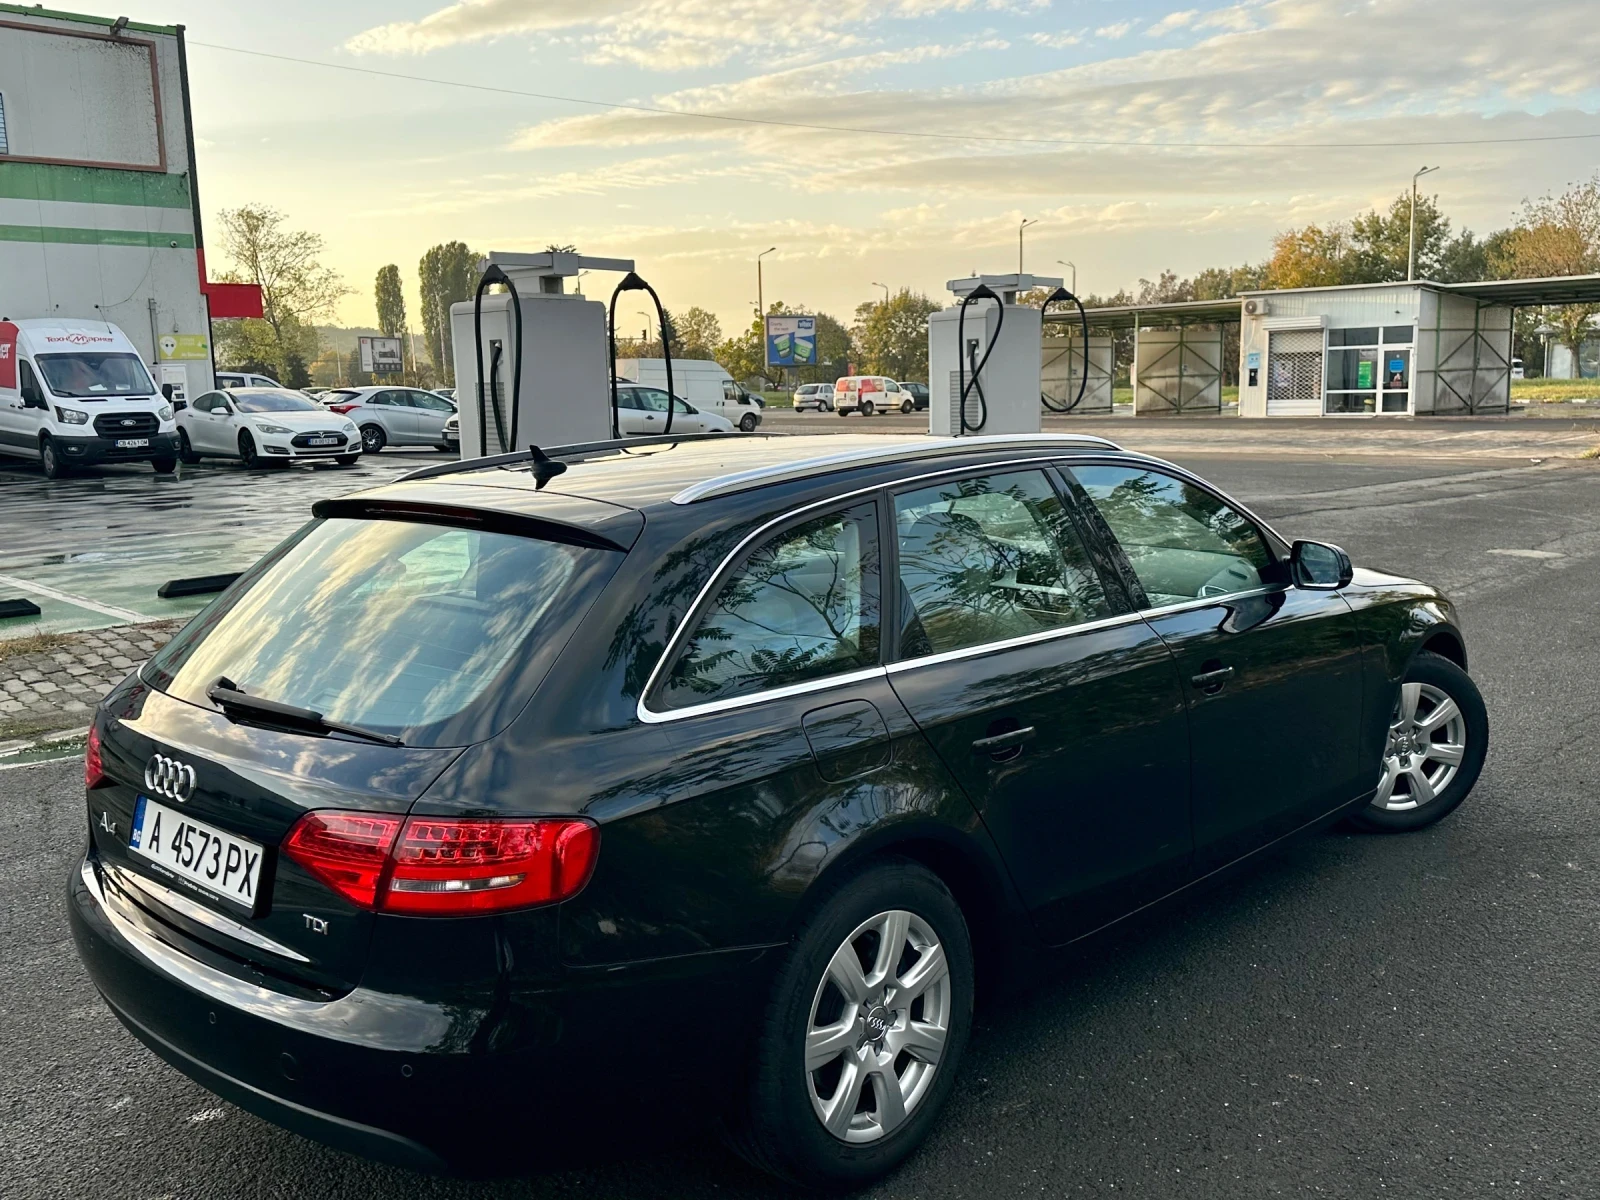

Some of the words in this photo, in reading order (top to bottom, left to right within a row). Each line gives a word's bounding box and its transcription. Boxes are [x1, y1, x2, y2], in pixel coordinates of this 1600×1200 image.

[132, 828, 141, 842] BG
[148, 811, 161, 853] A
[302, 913, 329, 936] TDI
